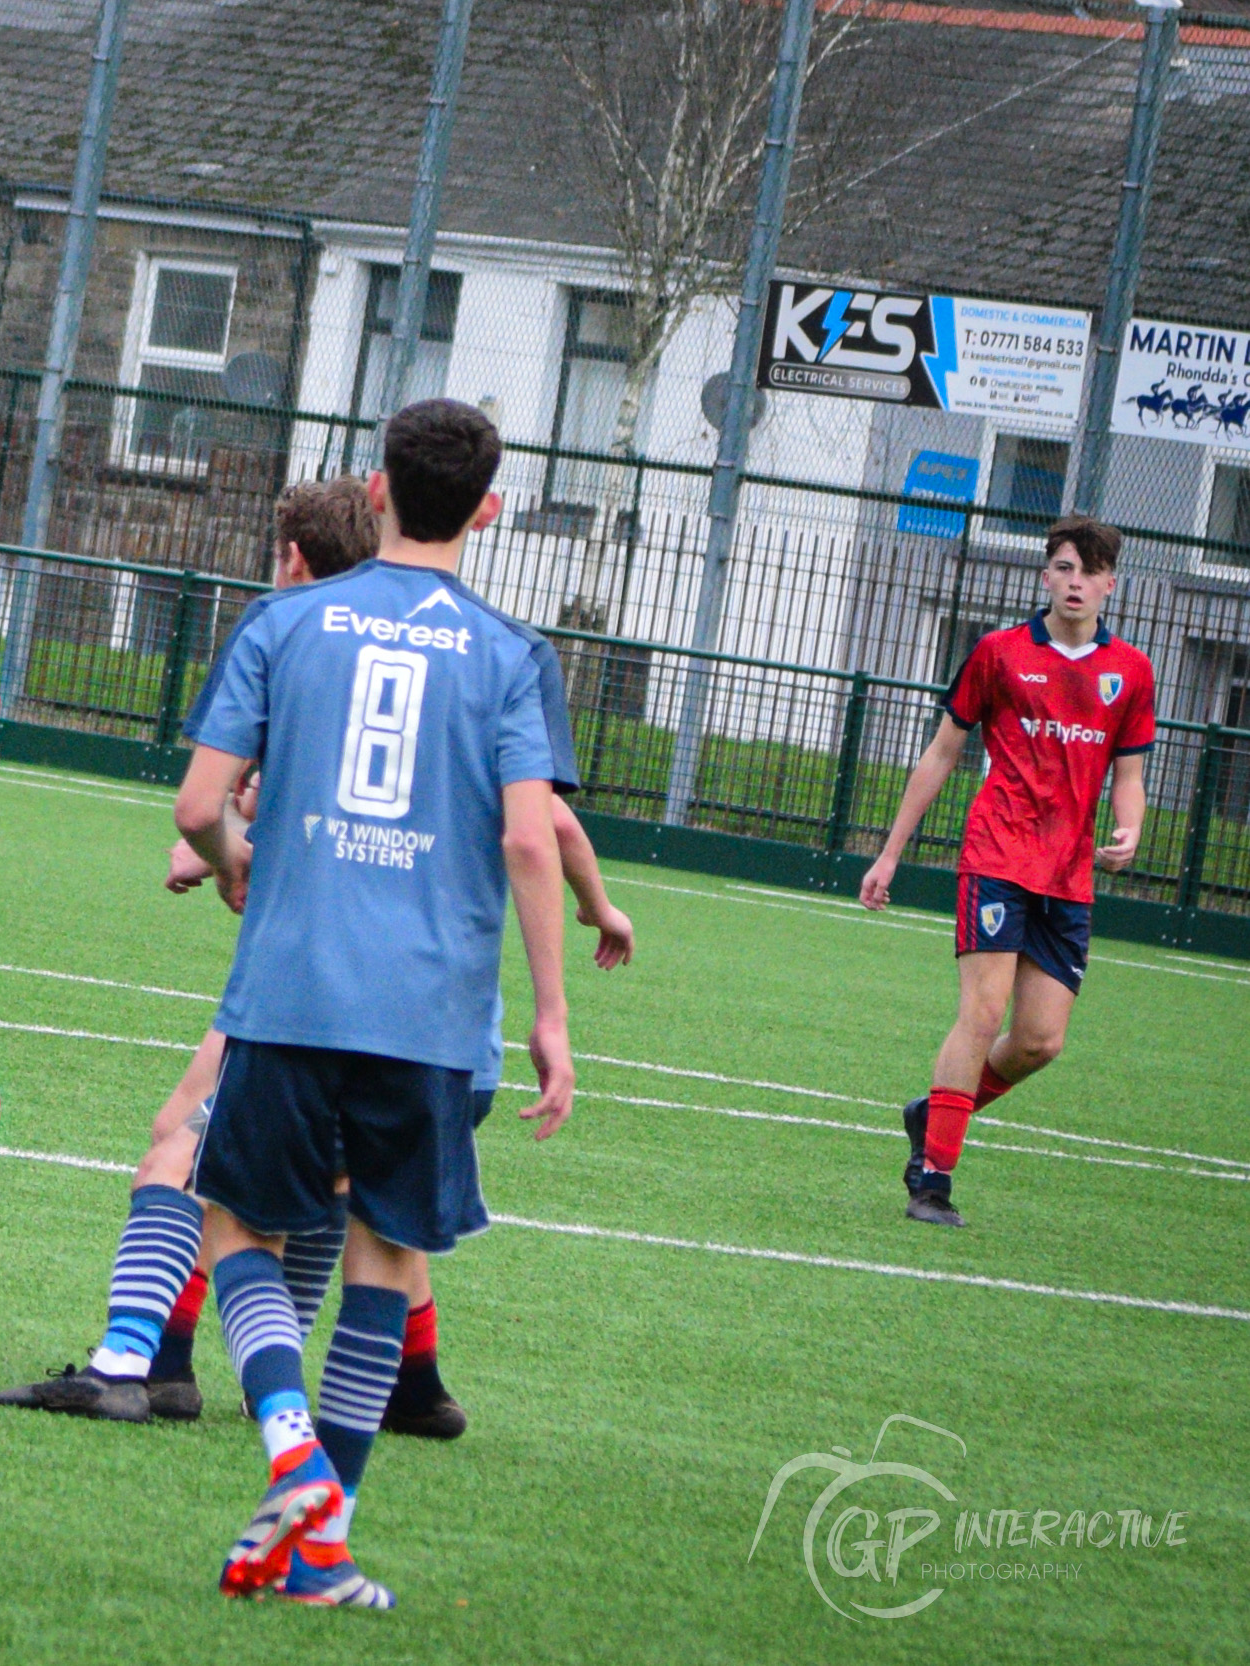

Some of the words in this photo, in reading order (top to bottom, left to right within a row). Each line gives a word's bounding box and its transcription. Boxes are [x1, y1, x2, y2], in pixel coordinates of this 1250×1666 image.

[772, 284, 923, 373] KES
[960, 306, 1009, 320] DOMESTIC
[1012, 313, 1019, 322] &
[1021, 313, 1087, 329] COMMERCIAL
[964, 329, 977, 346] T:
[980, 330, 1020, 350] 07771
[1023, 335, 1052, 354] 584
[1056, 338, 1084, 357] 533
[1130, 324, 1237, 364] MARTIN
[772, 367, 845, 387] ELECTRICAL
[849, 376, 906, 395] SERVICES
[1166, 361, 1238, 385] Rhondda's
[322, 605, 472, 655] Everest
[337, 643, 429, 820] 8
[327, 817, 349, 840] W2
[352, 822, 436, 853] WINDOW
[335, 840, 415, 870] SYSTEMS
